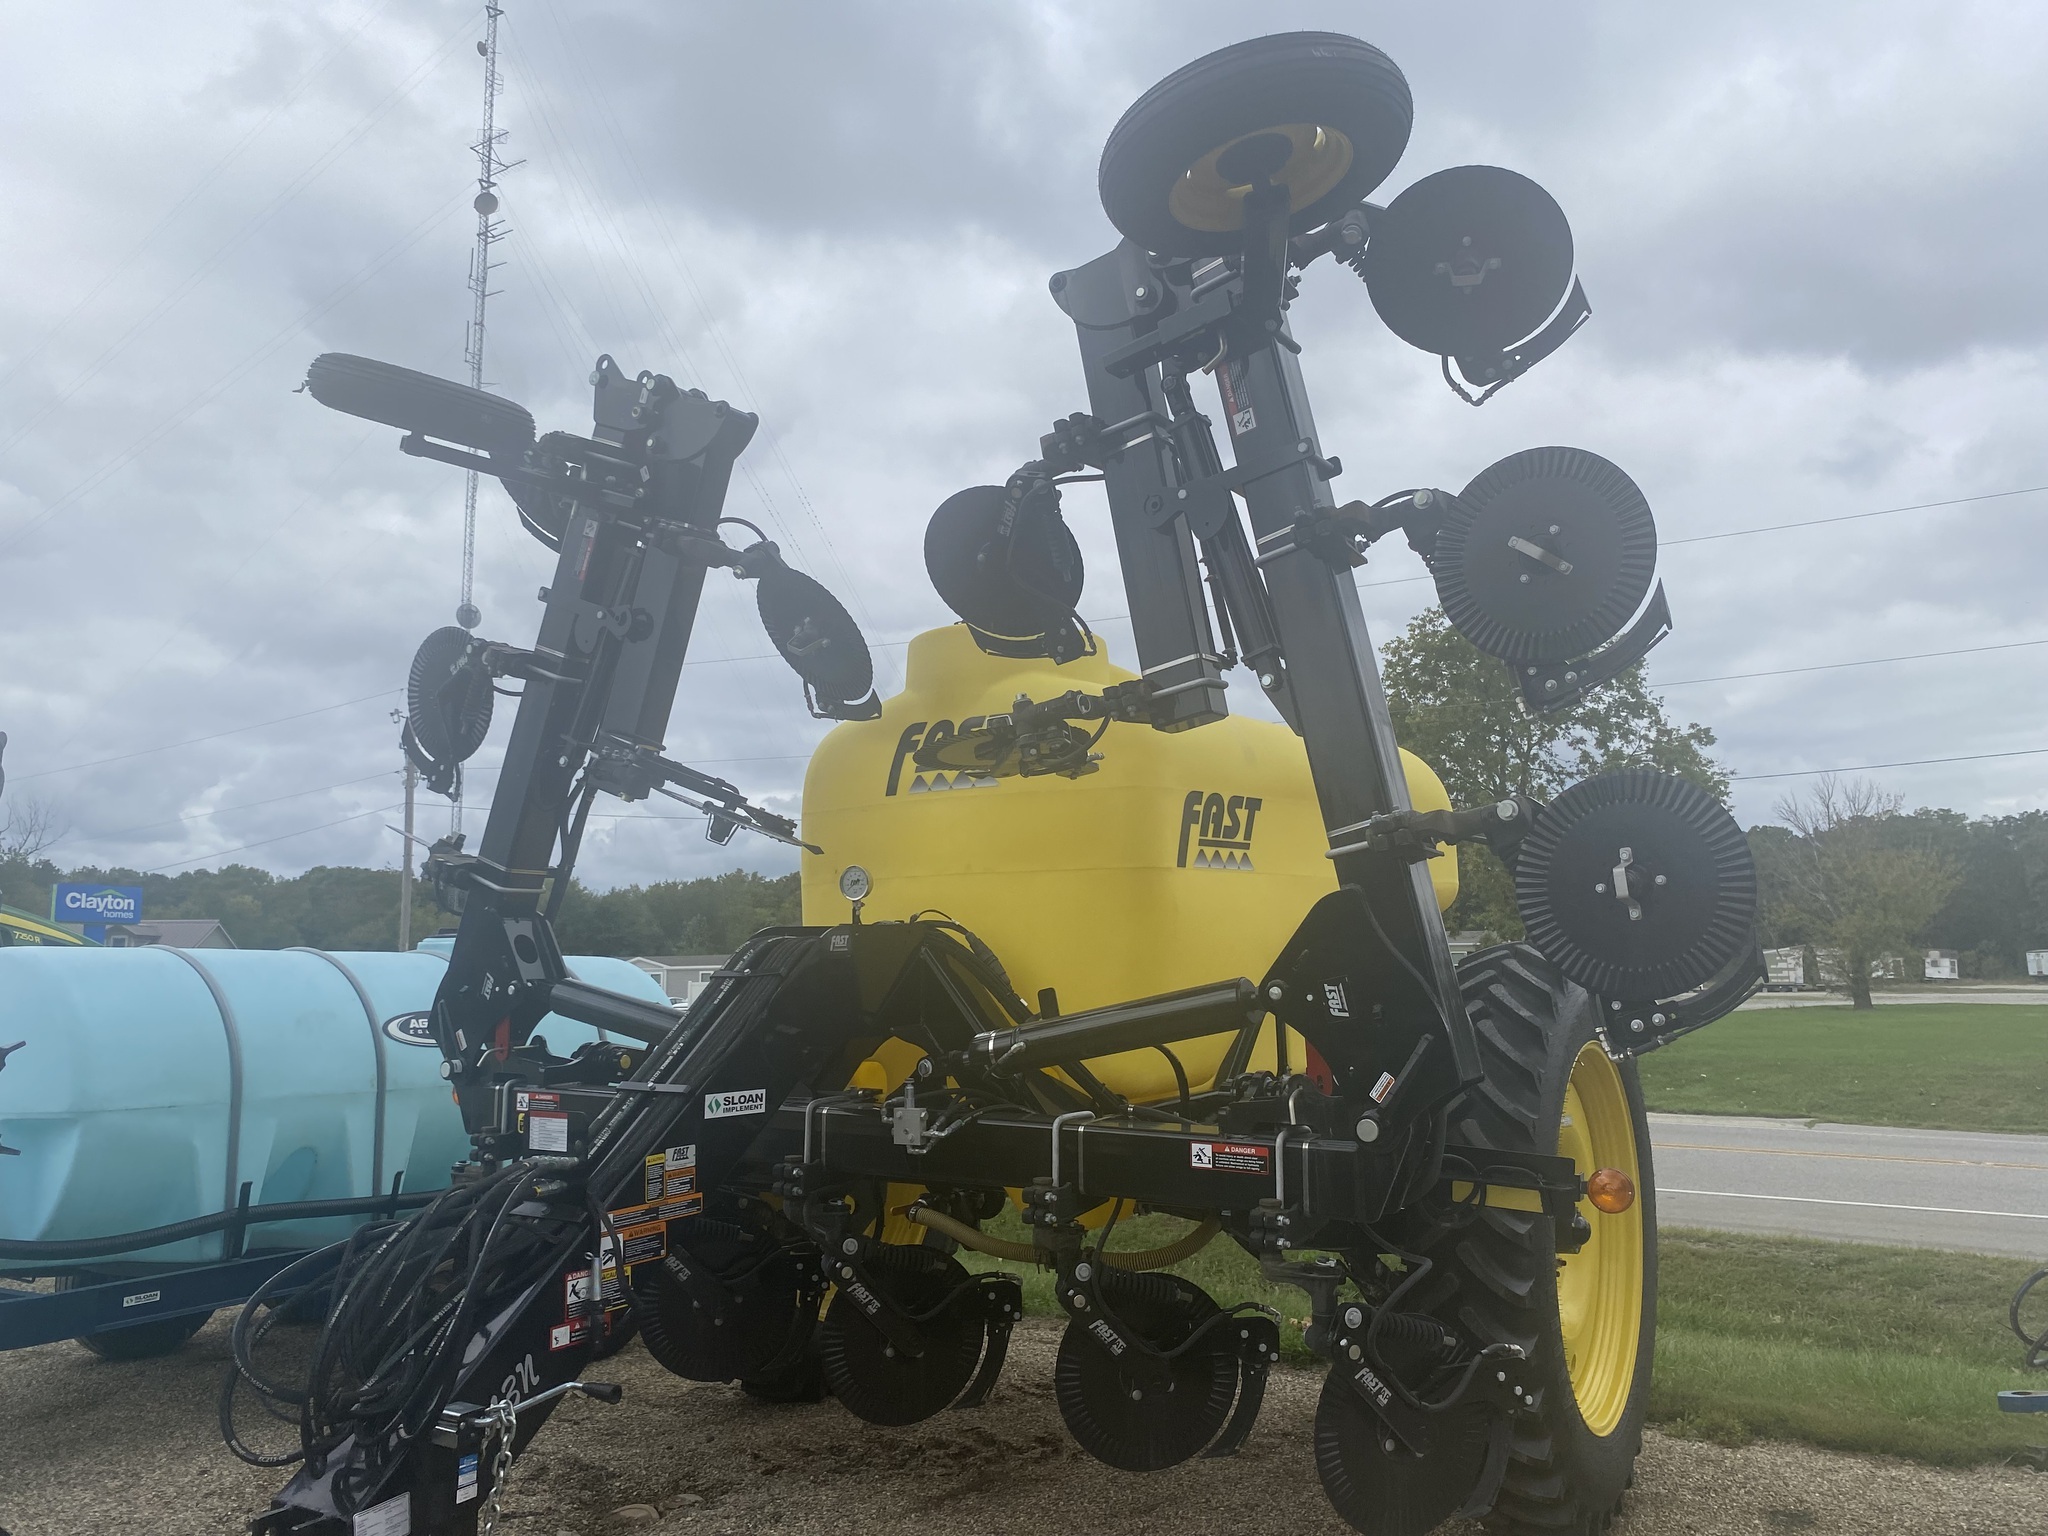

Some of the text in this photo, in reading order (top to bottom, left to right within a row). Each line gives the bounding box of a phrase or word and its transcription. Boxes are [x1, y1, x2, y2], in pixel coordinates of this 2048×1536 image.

[1177, 790, 1262, 868] FAST
[65, 892, 135, 912] Clayton
[103, 910, 134, 919] homes
[830, 935, 849, 952] FAST
[1323, 982, 1350, 1017] FAST
[723, 1093, 764, 1107] SLOAN
[722, 1103, 764, 1114] IMPLEMENT
[672, 1146, 690, 1162] FAST
[1231, 1146, 1256, 1155] DANGER
[572, 1269, 592, 1279] DANG
[134, 1292, 159, 1300] SLOAN
[847, 1282, 873, 1304] FAST
[1088, 1319, 1118, 1343] FAST
[1354, 1367, 1384, 1393] FAST
